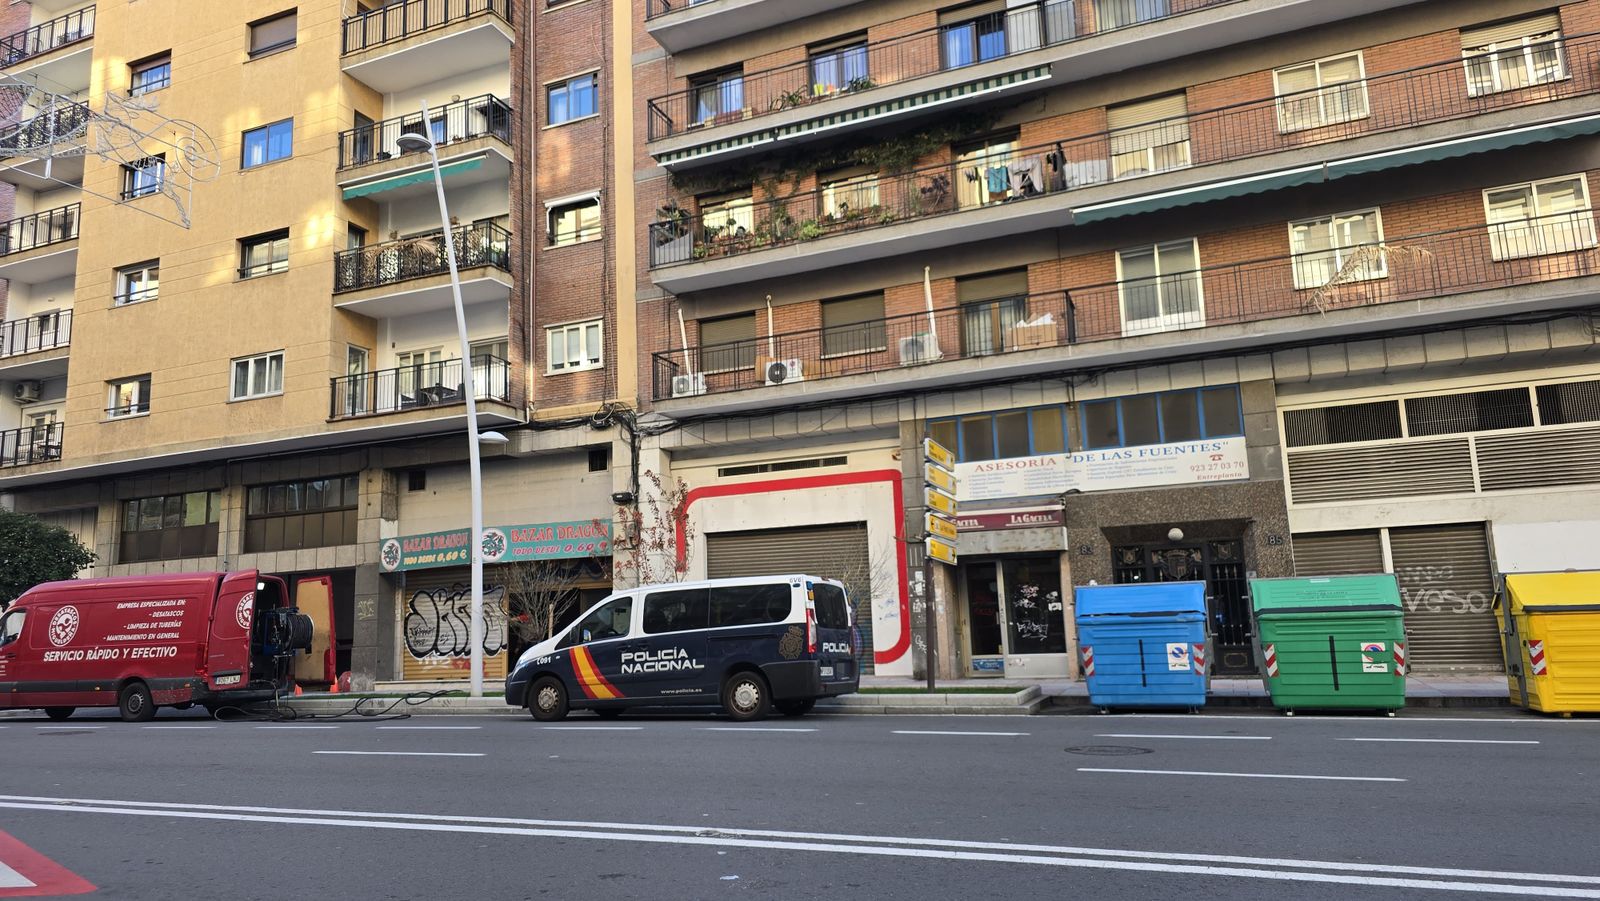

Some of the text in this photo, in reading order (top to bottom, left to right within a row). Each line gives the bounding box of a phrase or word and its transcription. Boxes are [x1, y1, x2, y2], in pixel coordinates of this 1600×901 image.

[975, 457, 1057, 472] ASESORÍA
[1073, 454, 1095, 463] DE
[1102, 451, 1133, 461] LAS
[1190, 464, 1205, 472] 923
[1208, 463, 1218, 471] 27
[511, 527, 554, 543] BAZAR
[403, 537, 432, 552] BAZAR
[404, 556, 417, 565] TODO
[418, 554, 436, 563] DESDE
[437, 551, 458, 562] 0,60
[140, 600, 176, 608] ESPECIALIZADA
[152, 610, 184, 618] DESATASCOS
[158, 620, 182, 629] TUBERÍAS
[157, 632, 179, 640] GENERAL
[43, 646, 177, 662] SERVICIO RÁPIDO Y EFECTIVO
[621, 646, 688, 663] POLICÍA
[621, 659, 705, 674] NACIONAL
